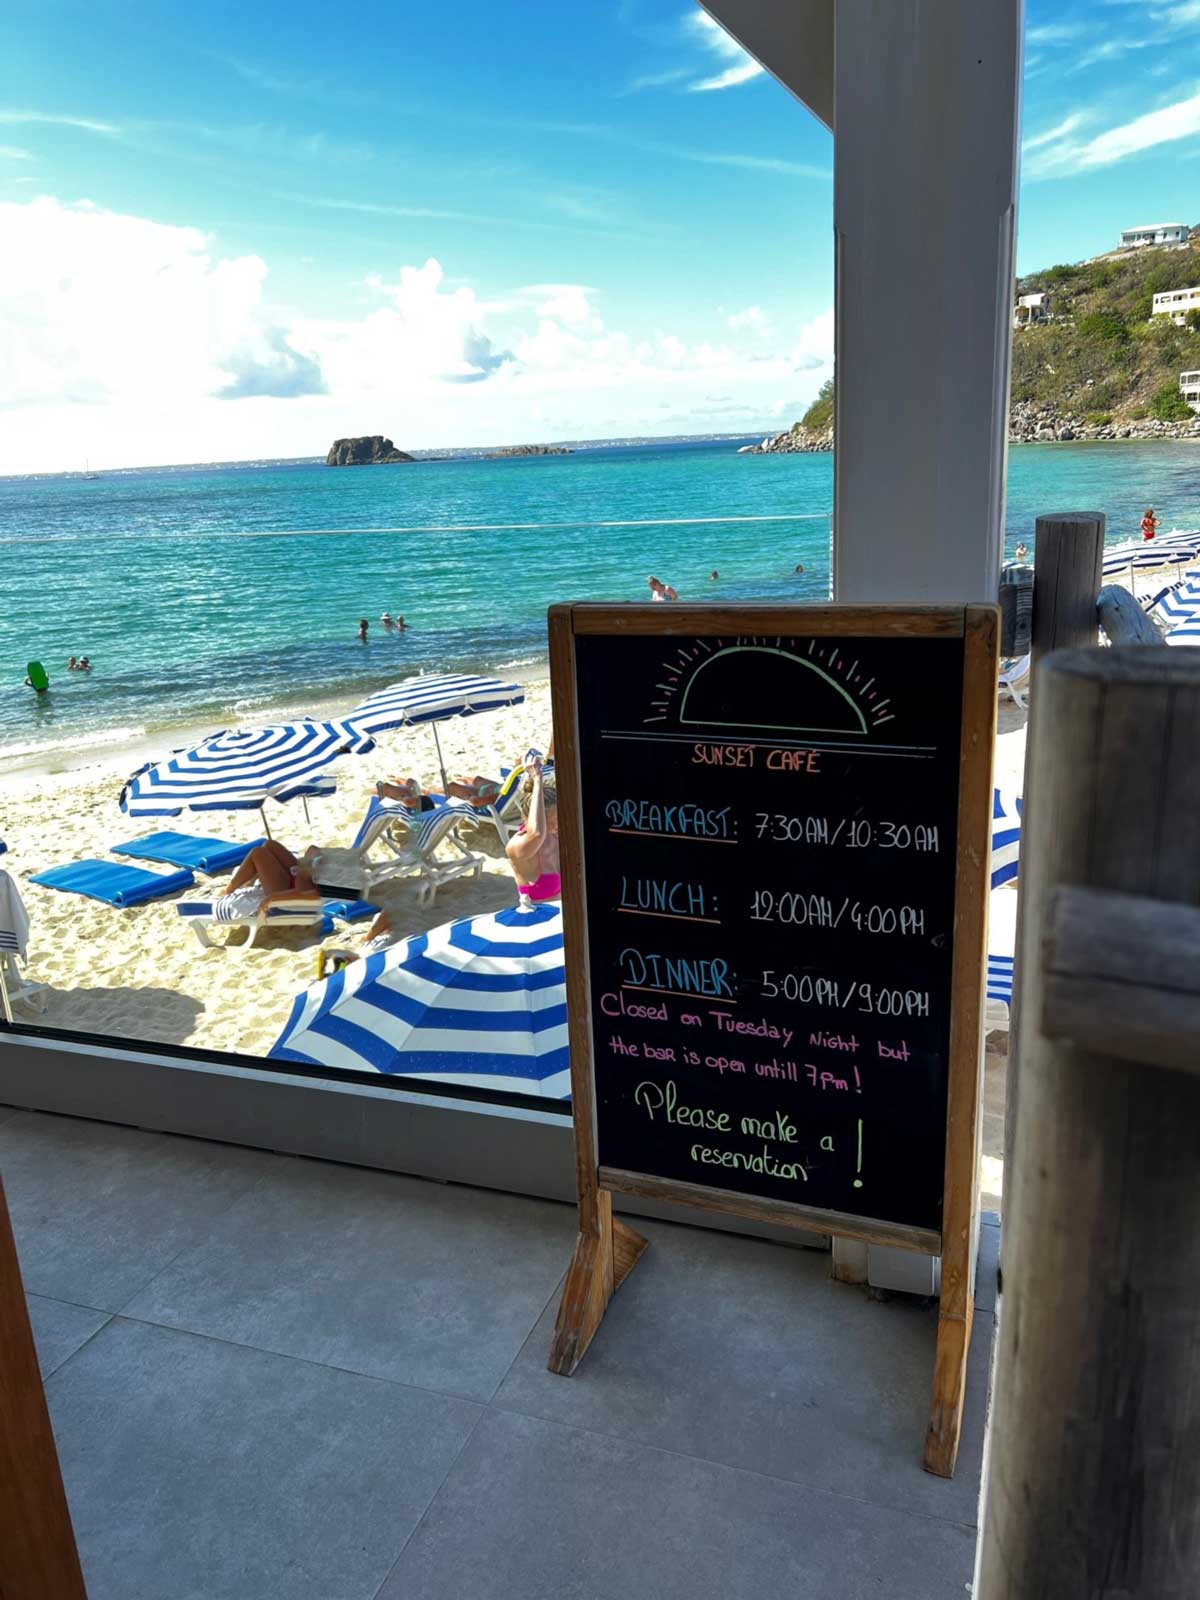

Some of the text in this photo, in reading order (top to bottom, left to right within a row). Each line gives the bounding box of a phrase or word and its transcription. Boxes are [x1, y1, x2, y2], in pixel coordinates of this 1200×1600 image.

[692, 743, 756, 768] SUNSET
[605, 799, 738, 838] BREAKFAST:
[620, 876, 719, 916] LUNCH:
[620, 948, 738, 997] DINNER:
[600, 990, 668, 1021] Closed
[680, 1013, 702, 1027] on
[708, 1011, 793, 1048] Tuesday
[878, 1040, 910, 1062] but
[609, 1035, 640, 1057] the
[683, 1046, 701, 1065] is
[705, 1056, 746, 1074] open
[755, 1058, 798, 1082] untill
[635, 1080, 732, 1132] Please
[741, 1110, 799, 1144] make
[819, 1135, 835, 1152] a
[690, 1145, 808, 1182] reservation
